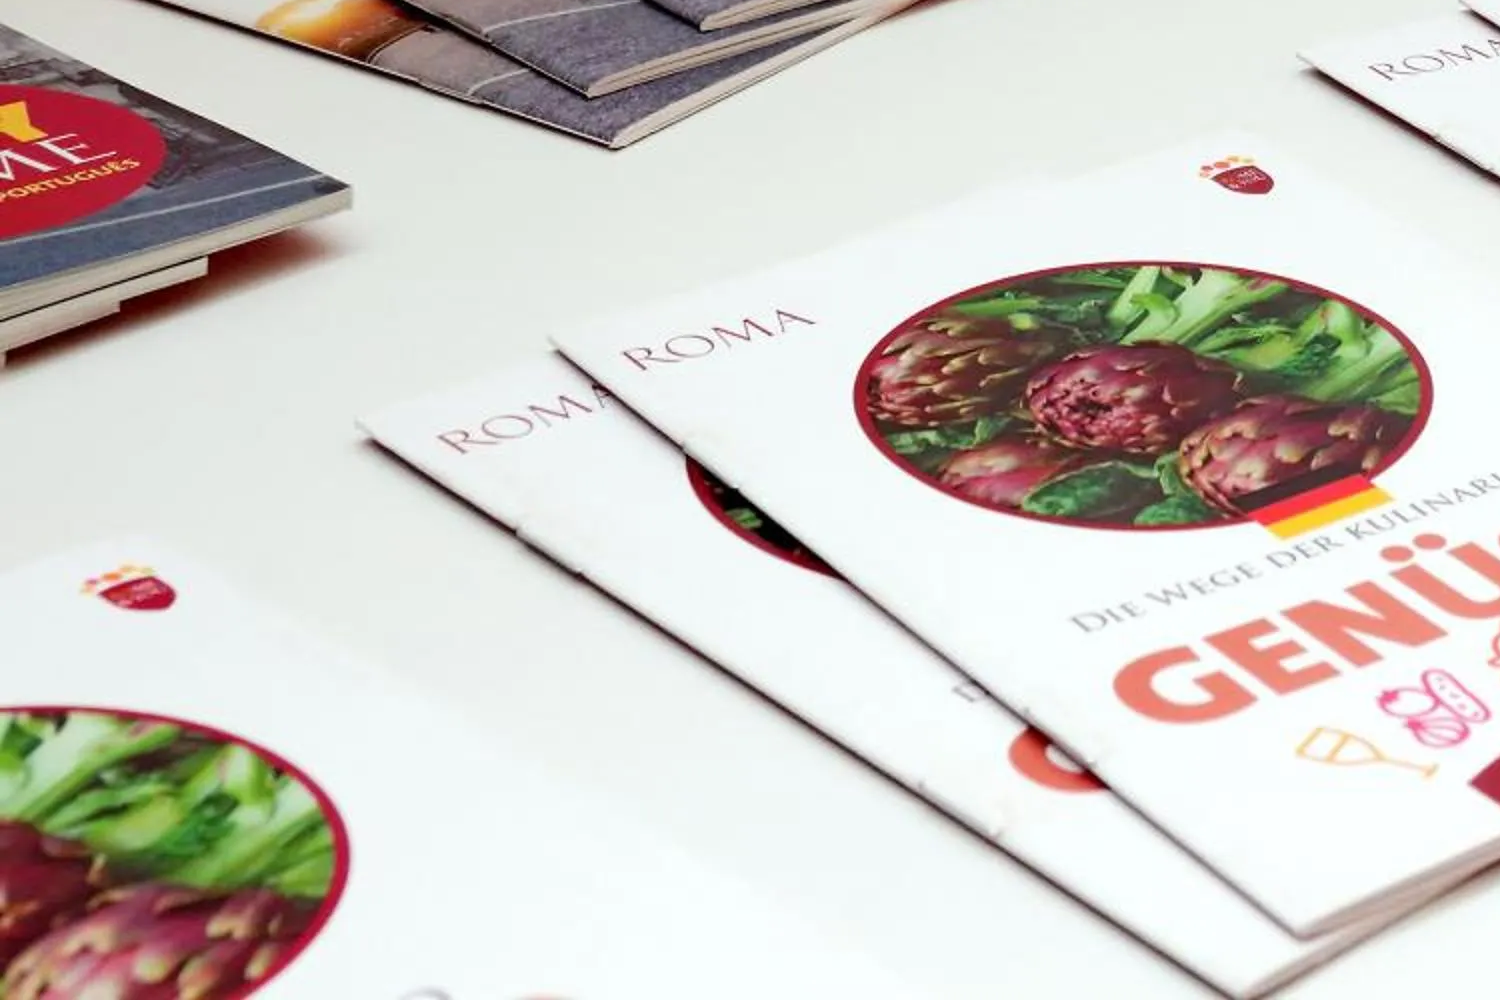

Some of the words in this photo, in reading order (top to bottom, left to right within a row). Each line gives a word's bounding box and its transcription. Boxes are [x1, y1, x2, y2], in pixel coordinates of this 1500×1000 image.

[621, 308, 817, 371] ROMA
[1148, 565, 1265, 606] WEGE
[1267, 533, 1346, 570] DER
